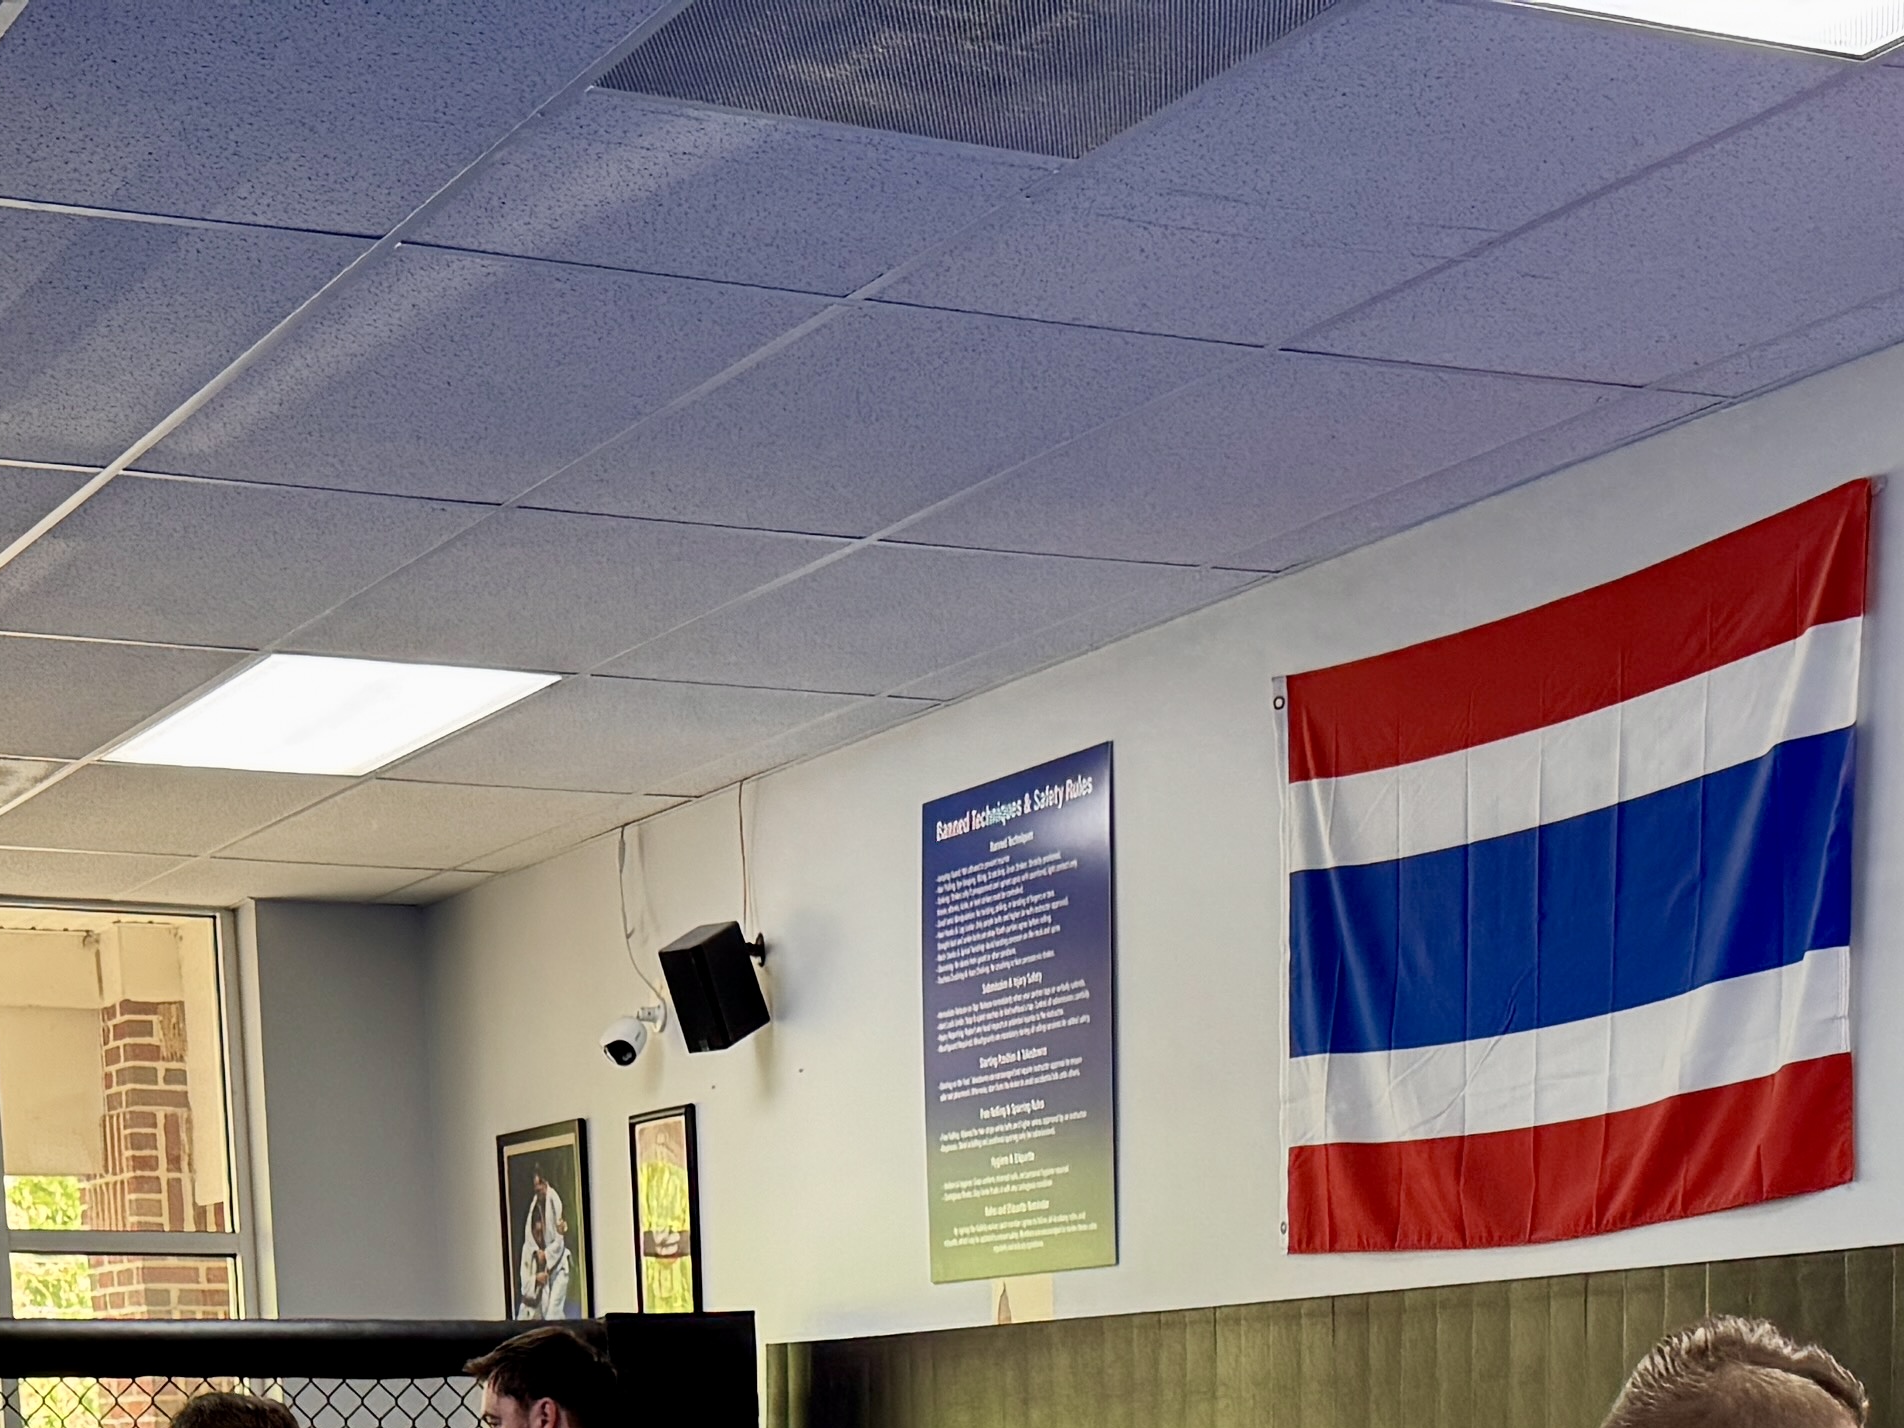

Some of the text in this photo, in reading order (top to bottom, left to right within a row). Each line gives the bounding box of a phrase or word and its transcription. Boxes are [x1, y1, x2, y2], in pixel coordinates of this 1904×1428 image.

[936, 774, 1093, 842] Banned Techniques & Safety Rules
